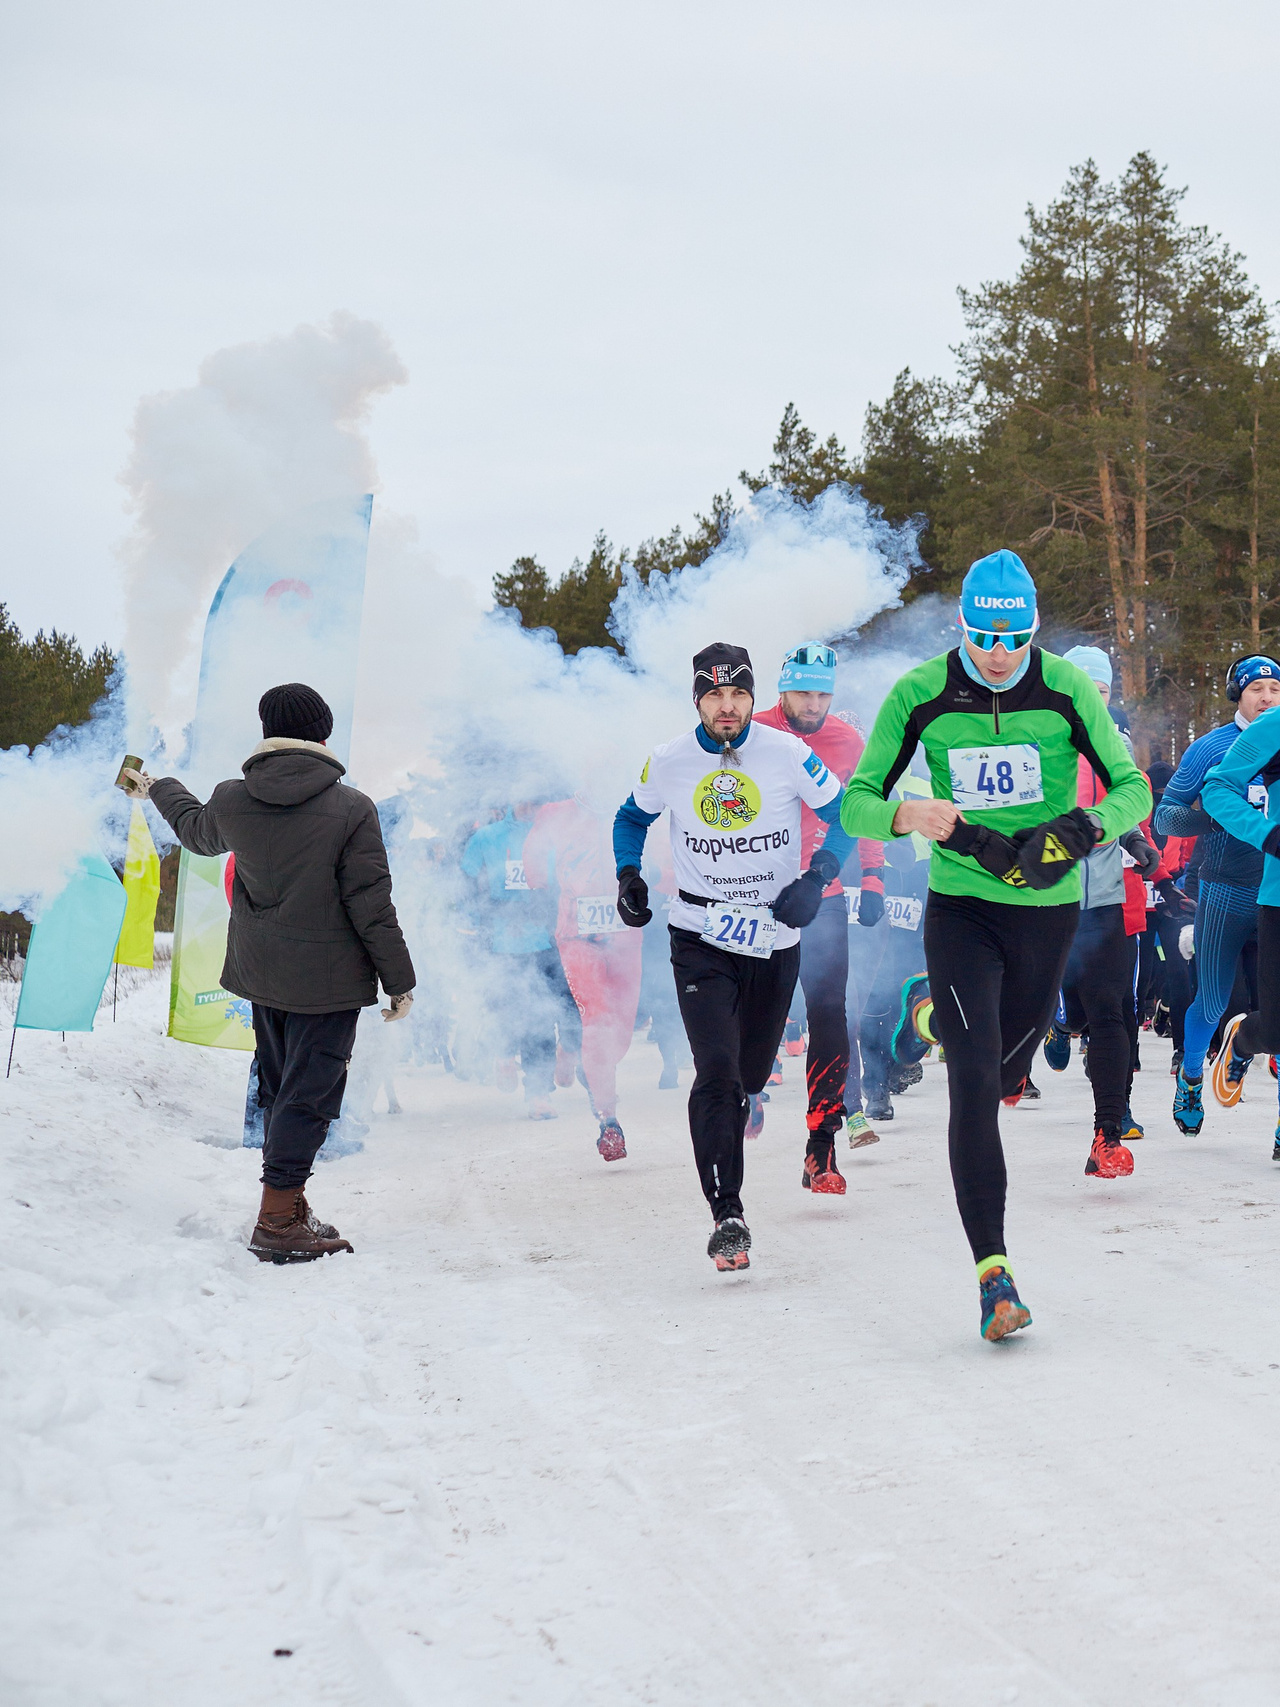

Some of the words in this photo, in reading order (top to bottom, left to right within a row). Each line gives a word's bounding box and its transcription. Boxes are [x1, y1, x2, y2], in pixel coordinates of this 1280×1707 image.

[974, 596, 1027, 609] LUKOIL
[977, 761, 1014, 796] 48
[703, 871, 775, 885] Тюменский
[723, 889, 760, 901] центр
[587, 904, 616, 927] 219
[715, 914, 759, 947] 241
